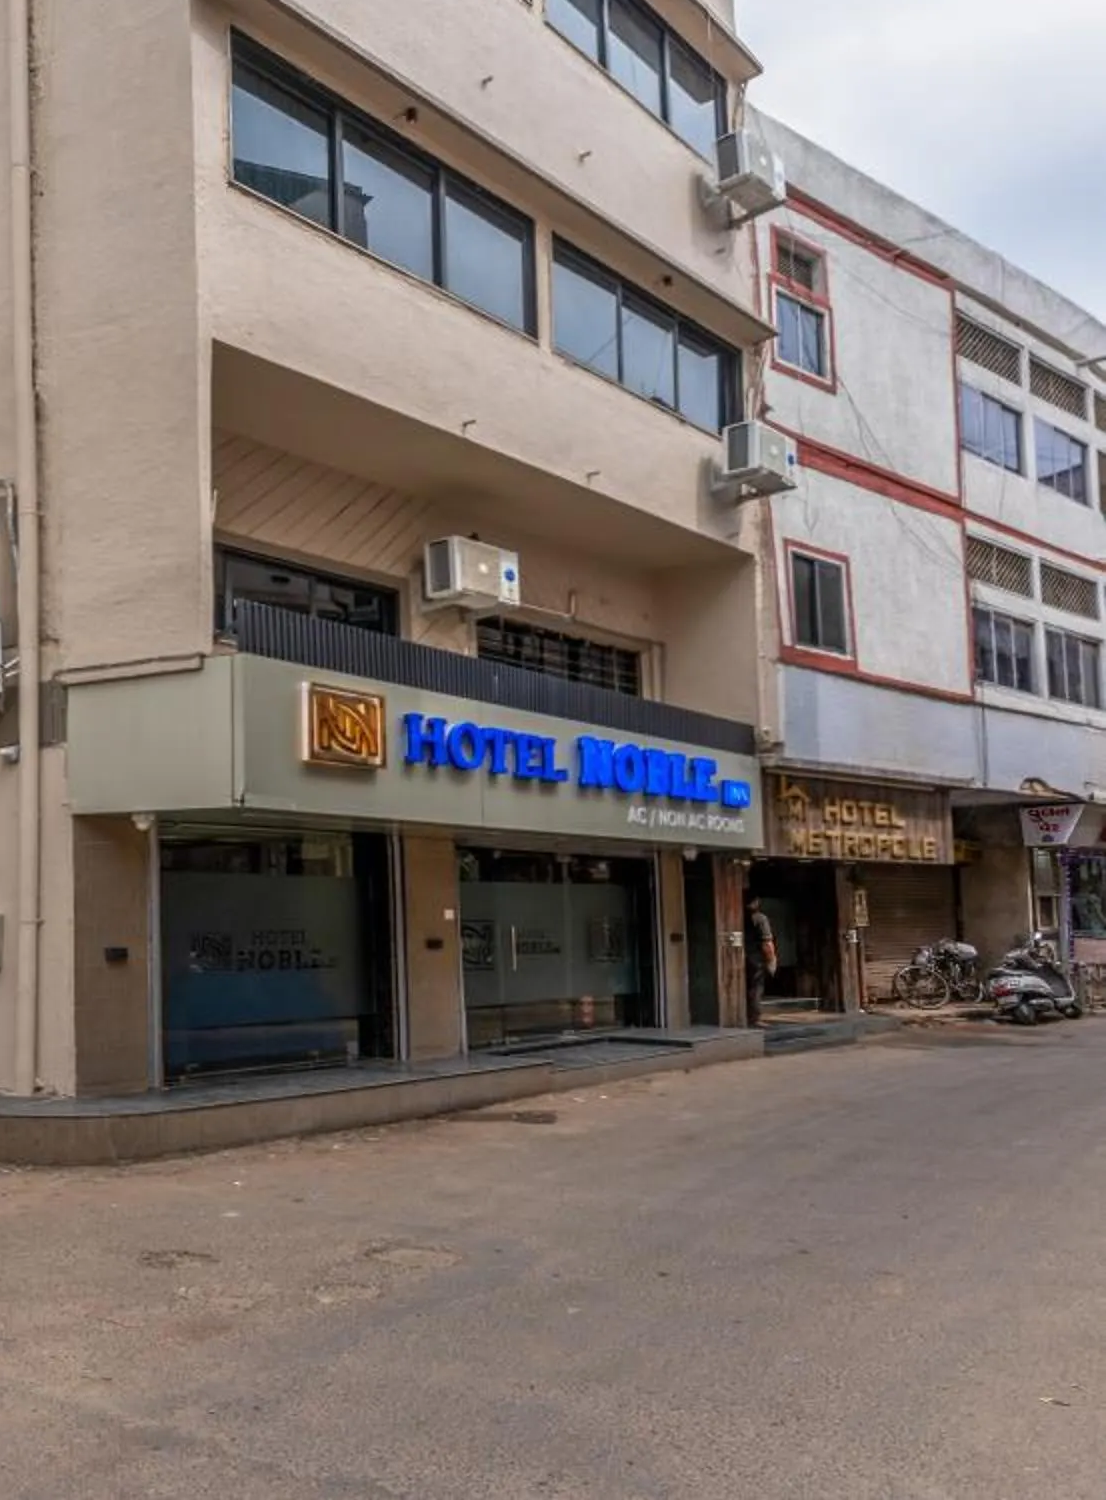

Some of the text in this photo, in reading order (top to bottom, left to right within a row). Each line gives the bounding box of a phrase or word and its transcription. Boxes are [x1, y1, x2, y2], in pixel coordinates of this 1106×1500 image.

[404, 713, 568, 782] HOTEL
[577, 736, 718, 803] NOBLE
[825, 799, 905, 827] HOTEL
[790, 829, 937, 860] METROPOLE
